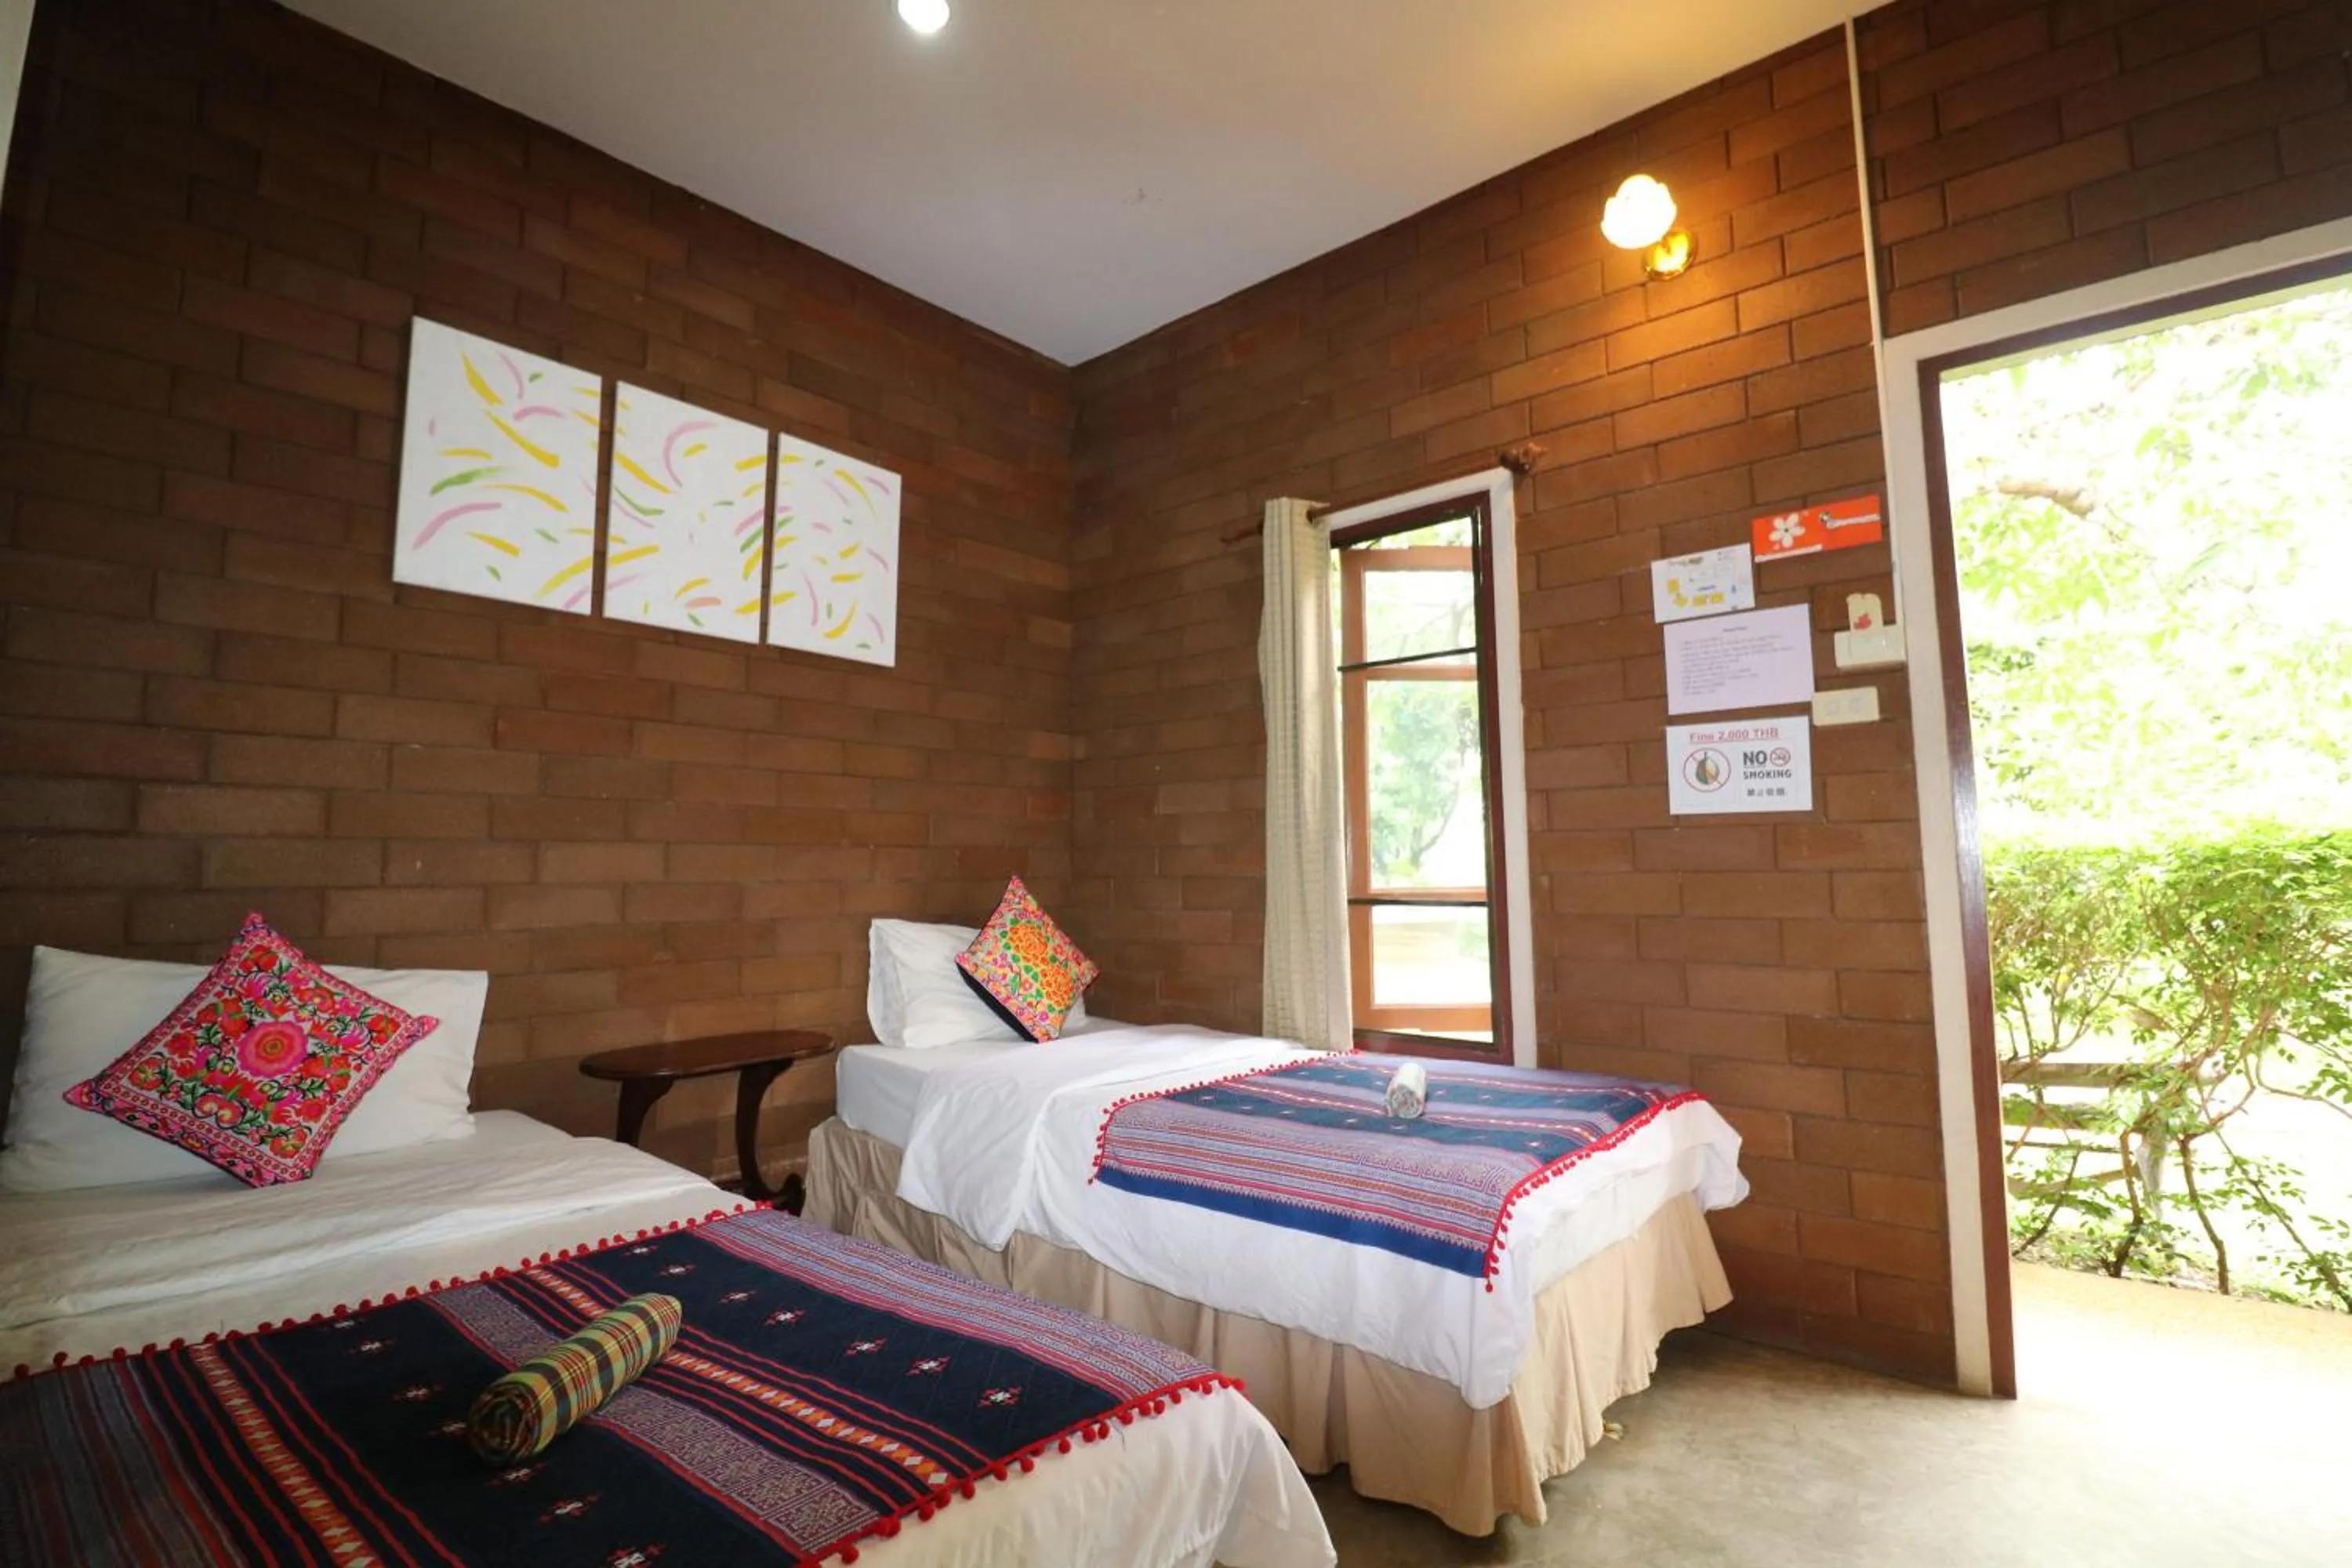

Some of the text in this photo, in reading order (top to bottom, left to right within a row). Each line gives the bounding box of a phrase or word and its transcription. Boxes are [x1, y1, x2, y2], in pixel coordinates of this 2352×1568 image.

[1718, 728, 1749, 740] 2,000
[1753, 727, 1779, 739] THB
[1743, 750, 1767, 765] NO
[1743, 769, 1792, 780] SMOKING
